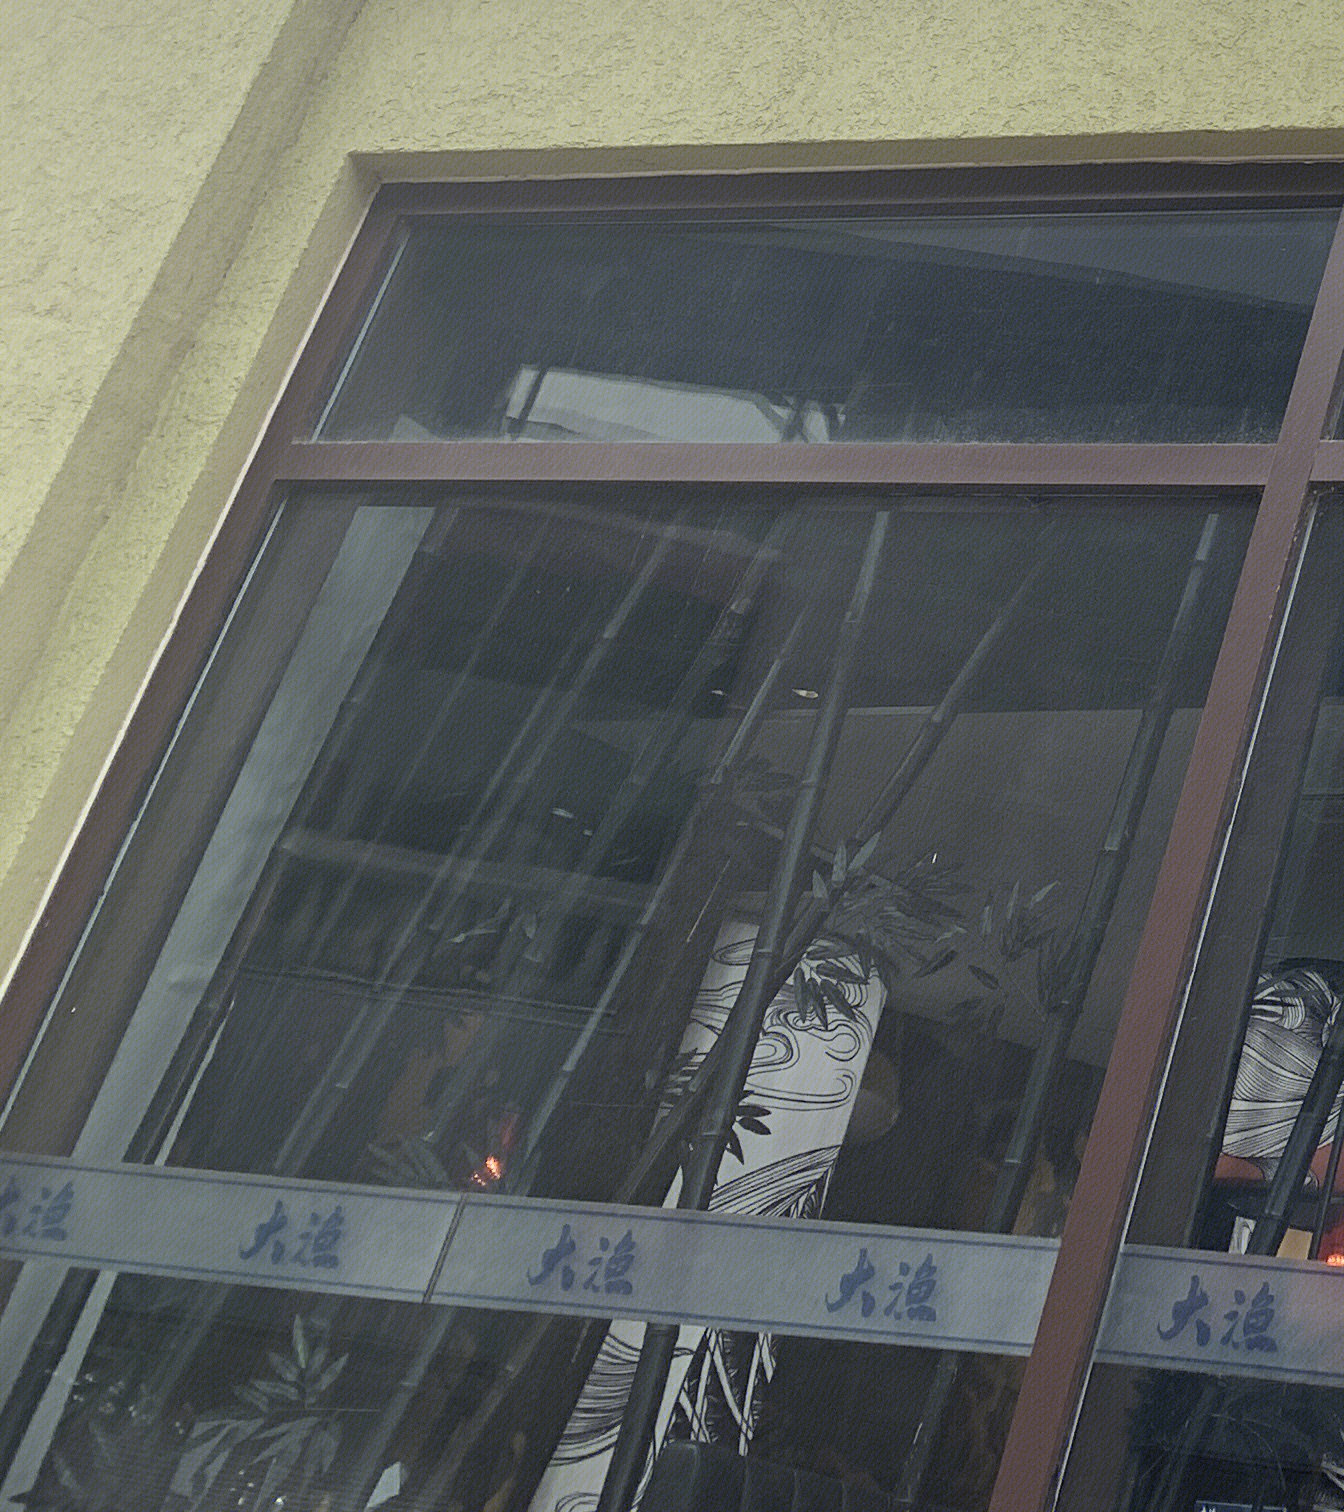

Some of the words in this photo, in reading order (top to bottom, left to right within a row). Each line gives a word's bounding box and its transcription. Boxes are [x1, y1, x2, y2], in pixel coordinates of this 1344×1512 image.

[239, 1199, 345, 1270] 大渔
[527, 1224, 637, 1297] 大渔
[825, 1248, 938, 1324] 大渔
[1157, 1276, 1280, 1355] 大渔
